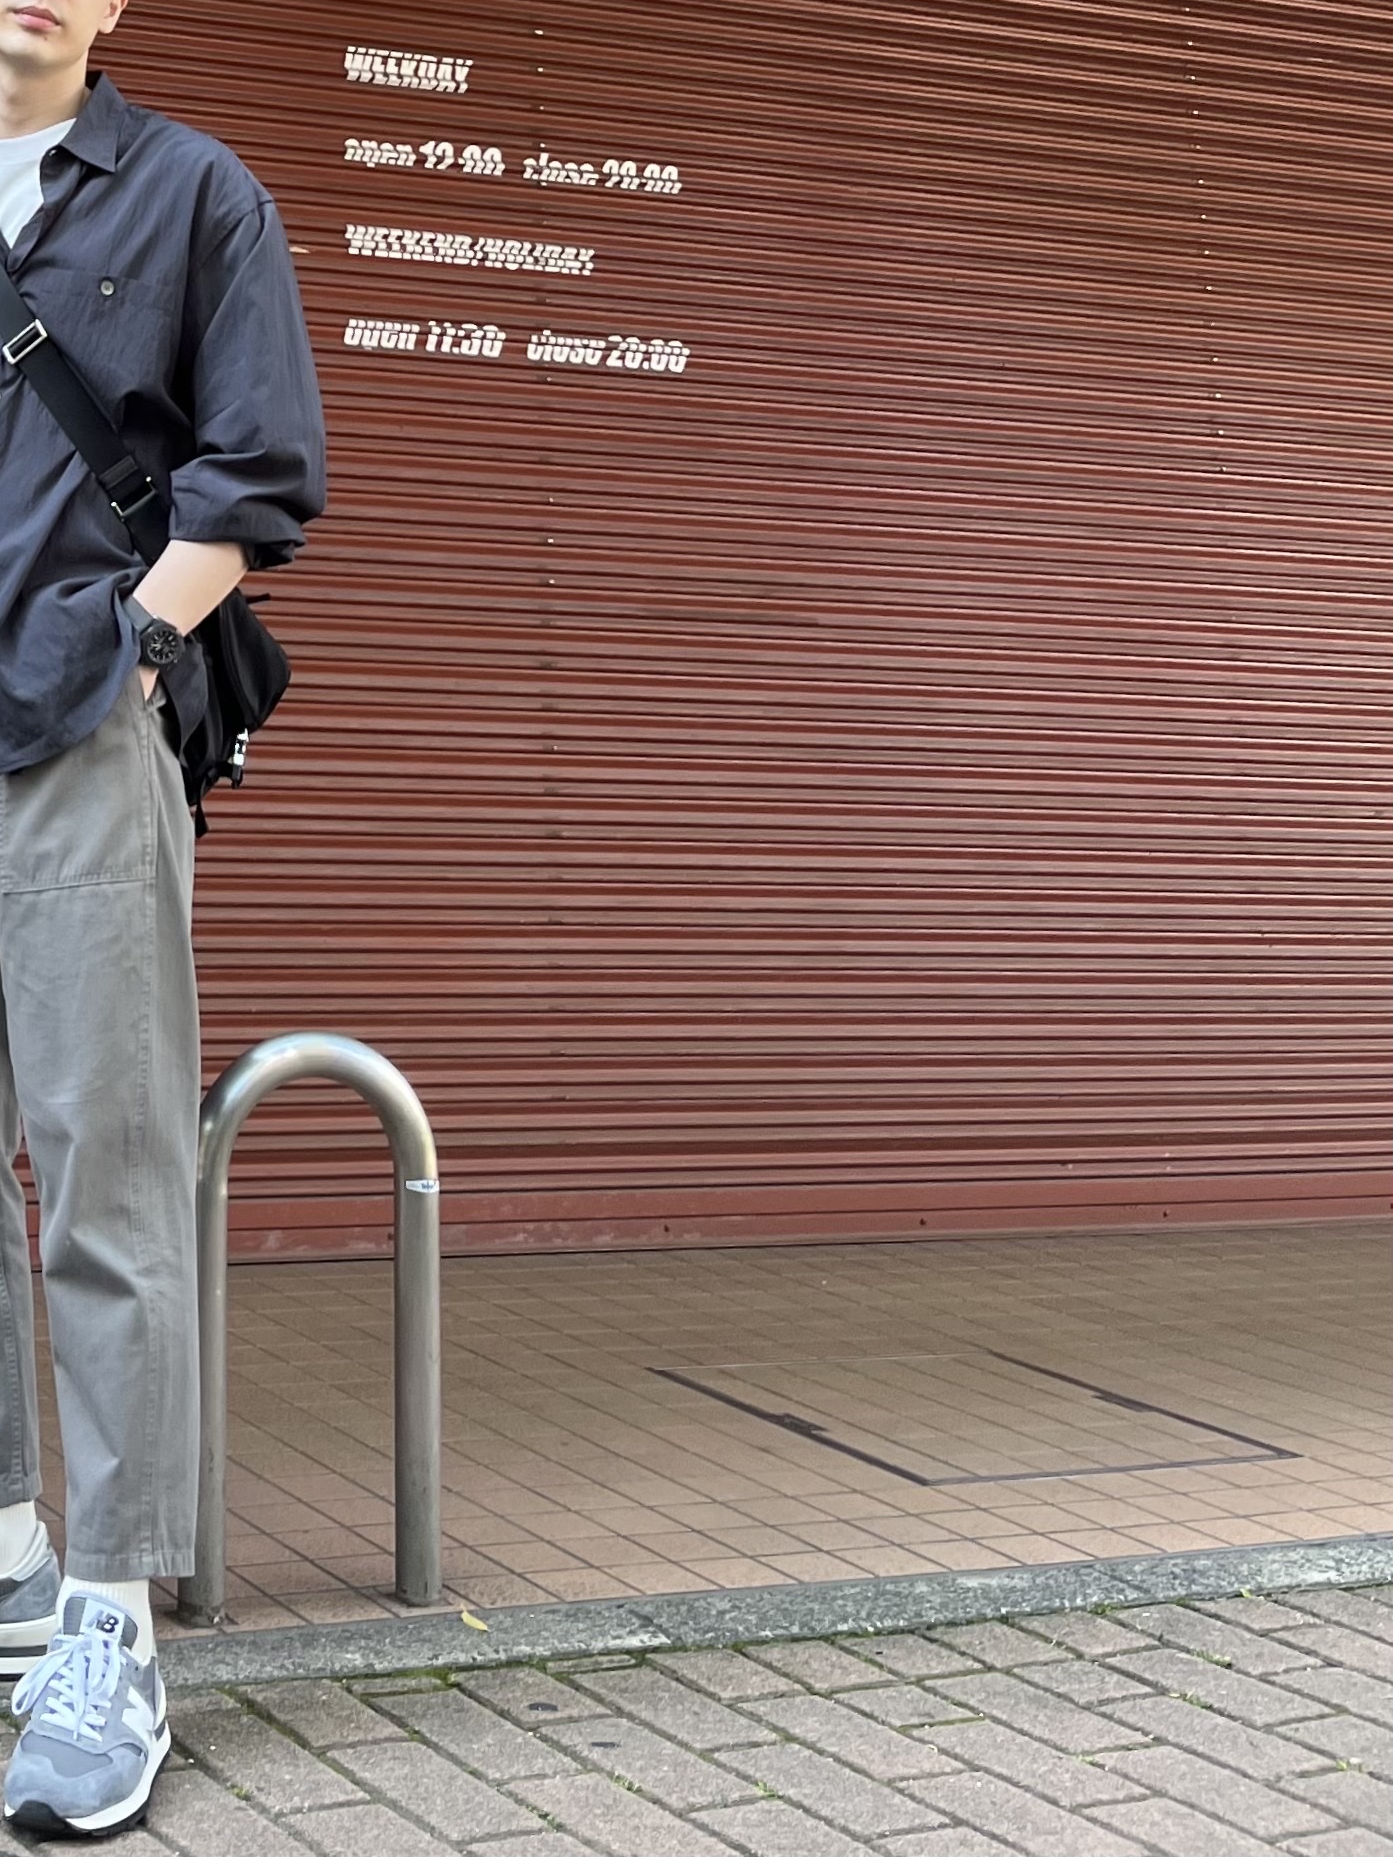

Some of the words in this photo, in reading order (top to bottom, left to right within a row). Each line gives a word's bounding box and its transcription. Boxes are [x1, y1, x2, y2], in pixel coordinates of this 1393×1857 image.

[344, 45, 474, 94] WEEKDAY
[343, 138, 417, 168] open
[523, 152, 599, 186] close
[343, 318, 421, 351] open
[526, 329, 606, 366] close
